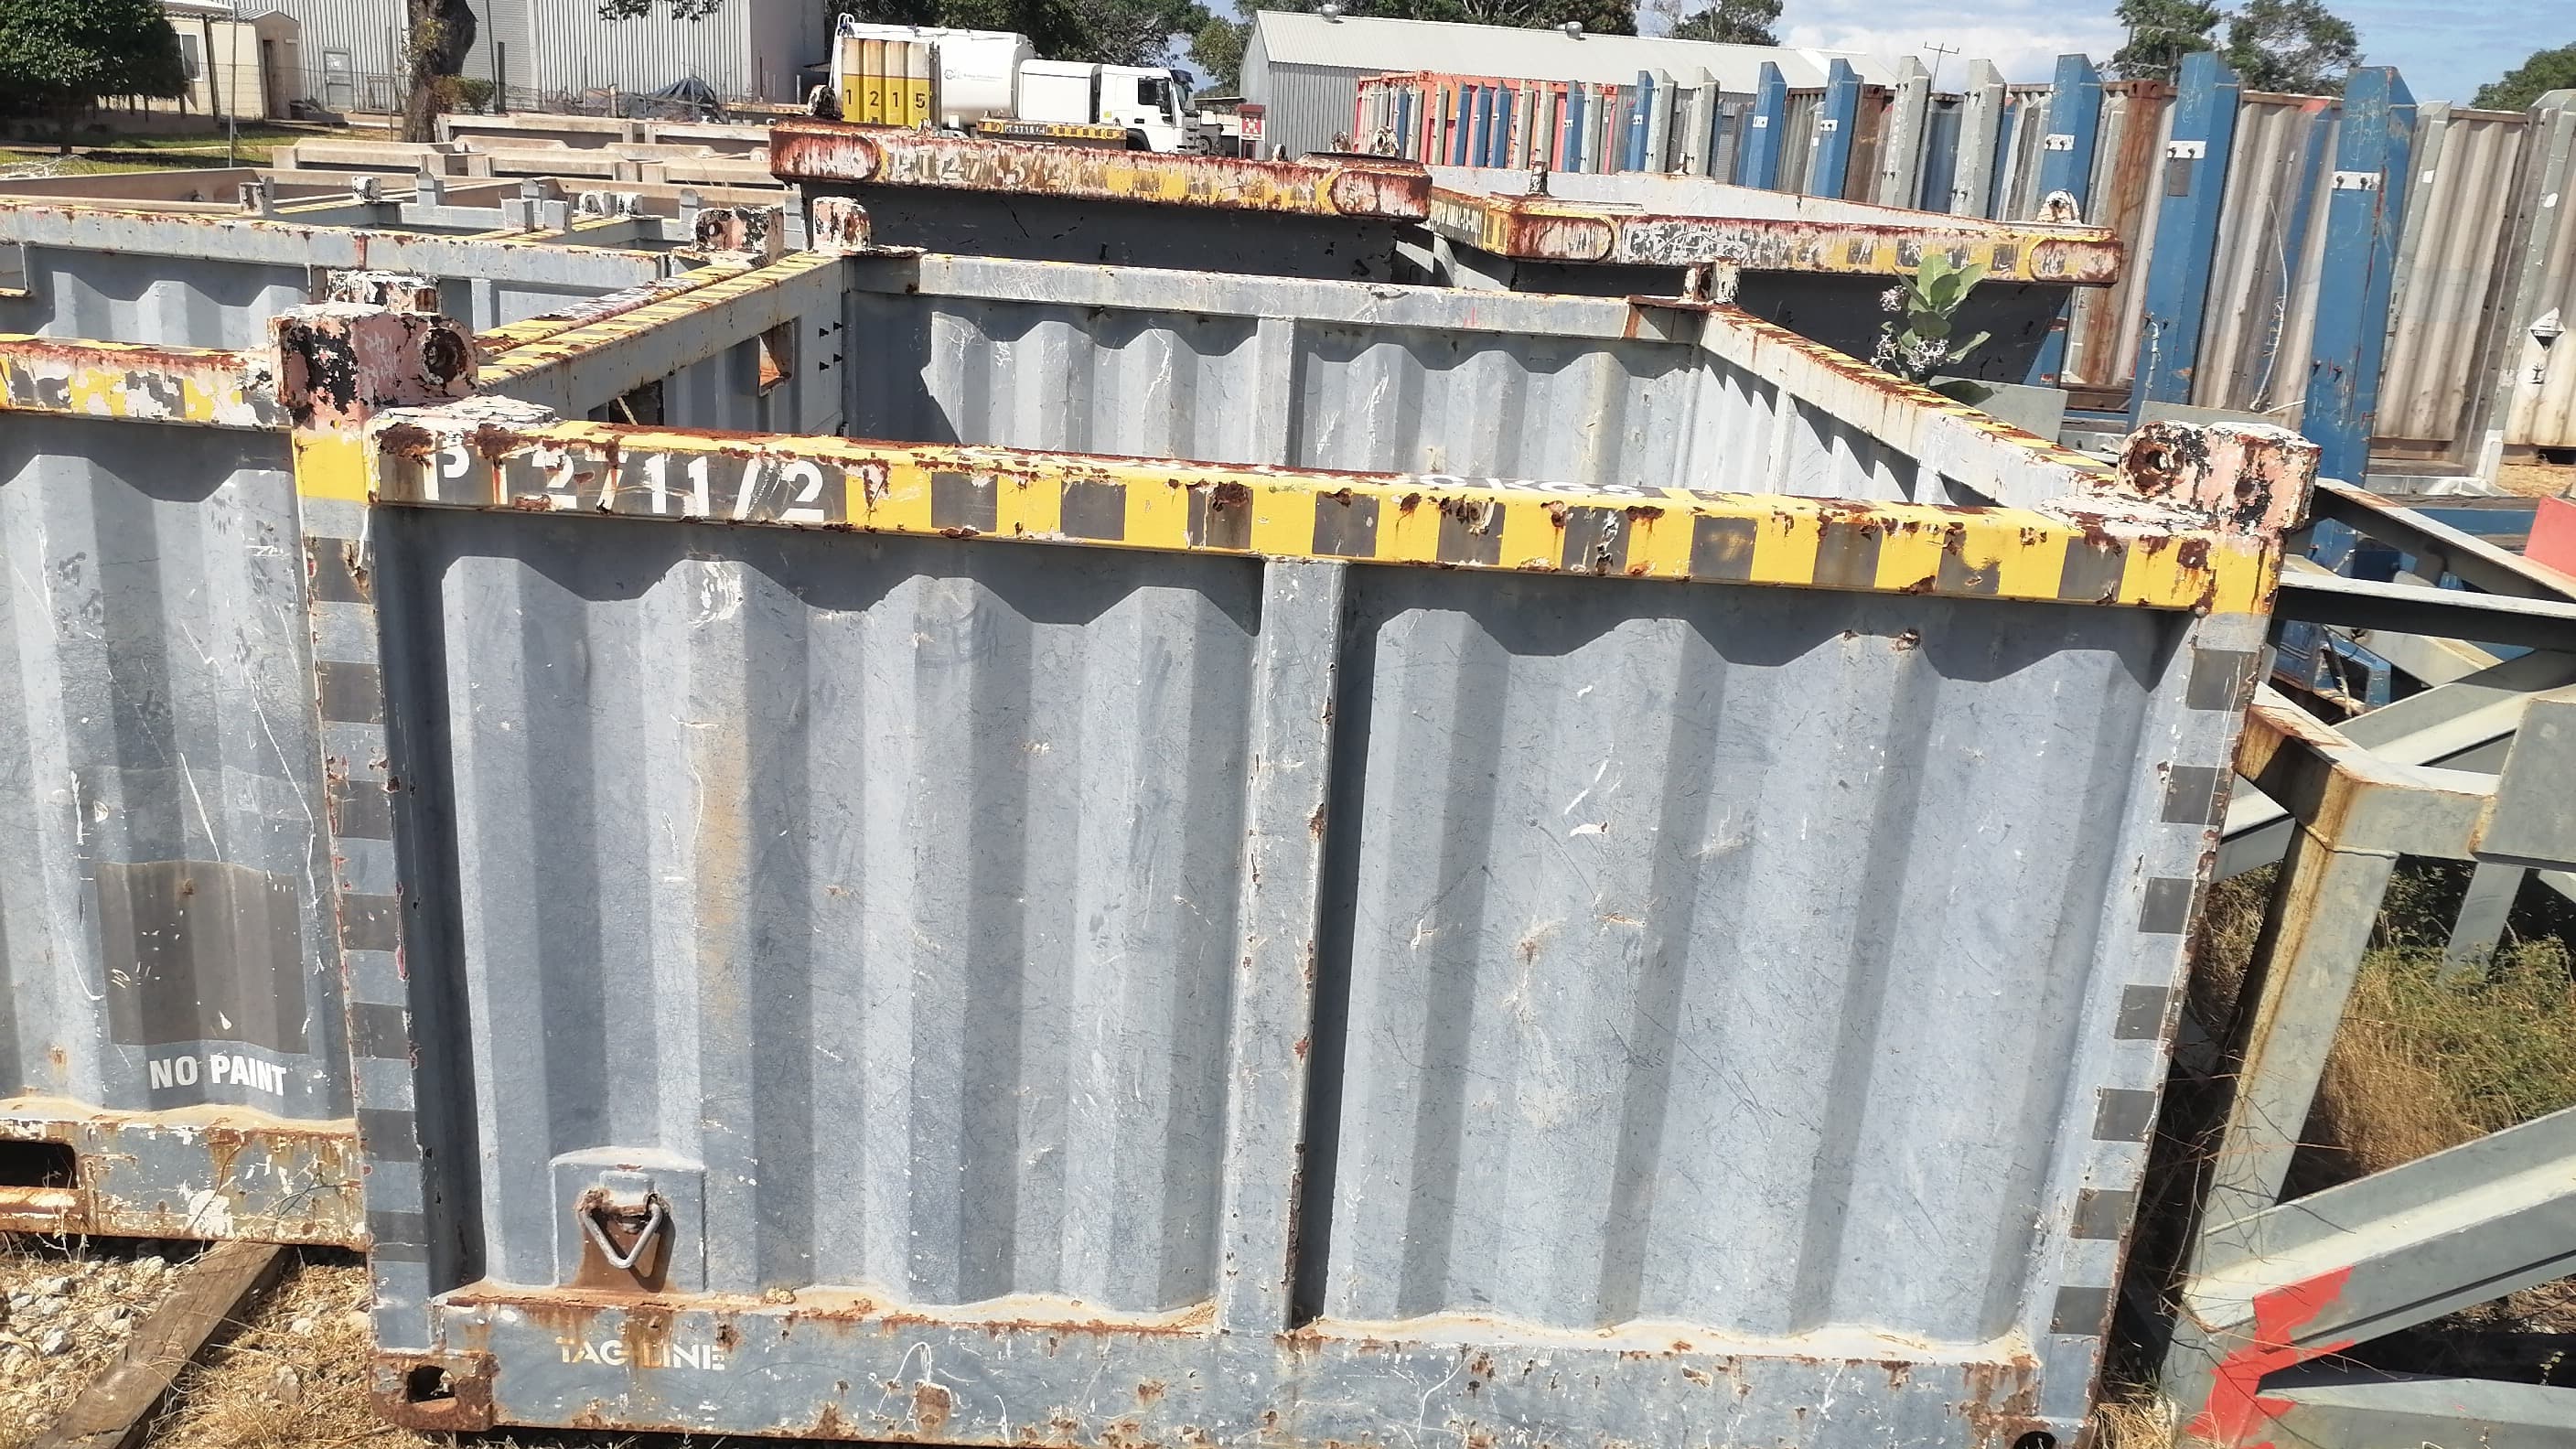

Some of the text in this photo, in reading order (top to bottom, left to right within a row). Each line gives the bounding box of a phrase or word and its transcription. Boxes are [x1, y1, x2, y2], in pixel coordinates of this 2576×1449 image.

[845, 89, 926, 109] 1215
[149, 1055, 287, 1096] NO PAINT
[555, 1336, 726, 1371] TAG LINE
